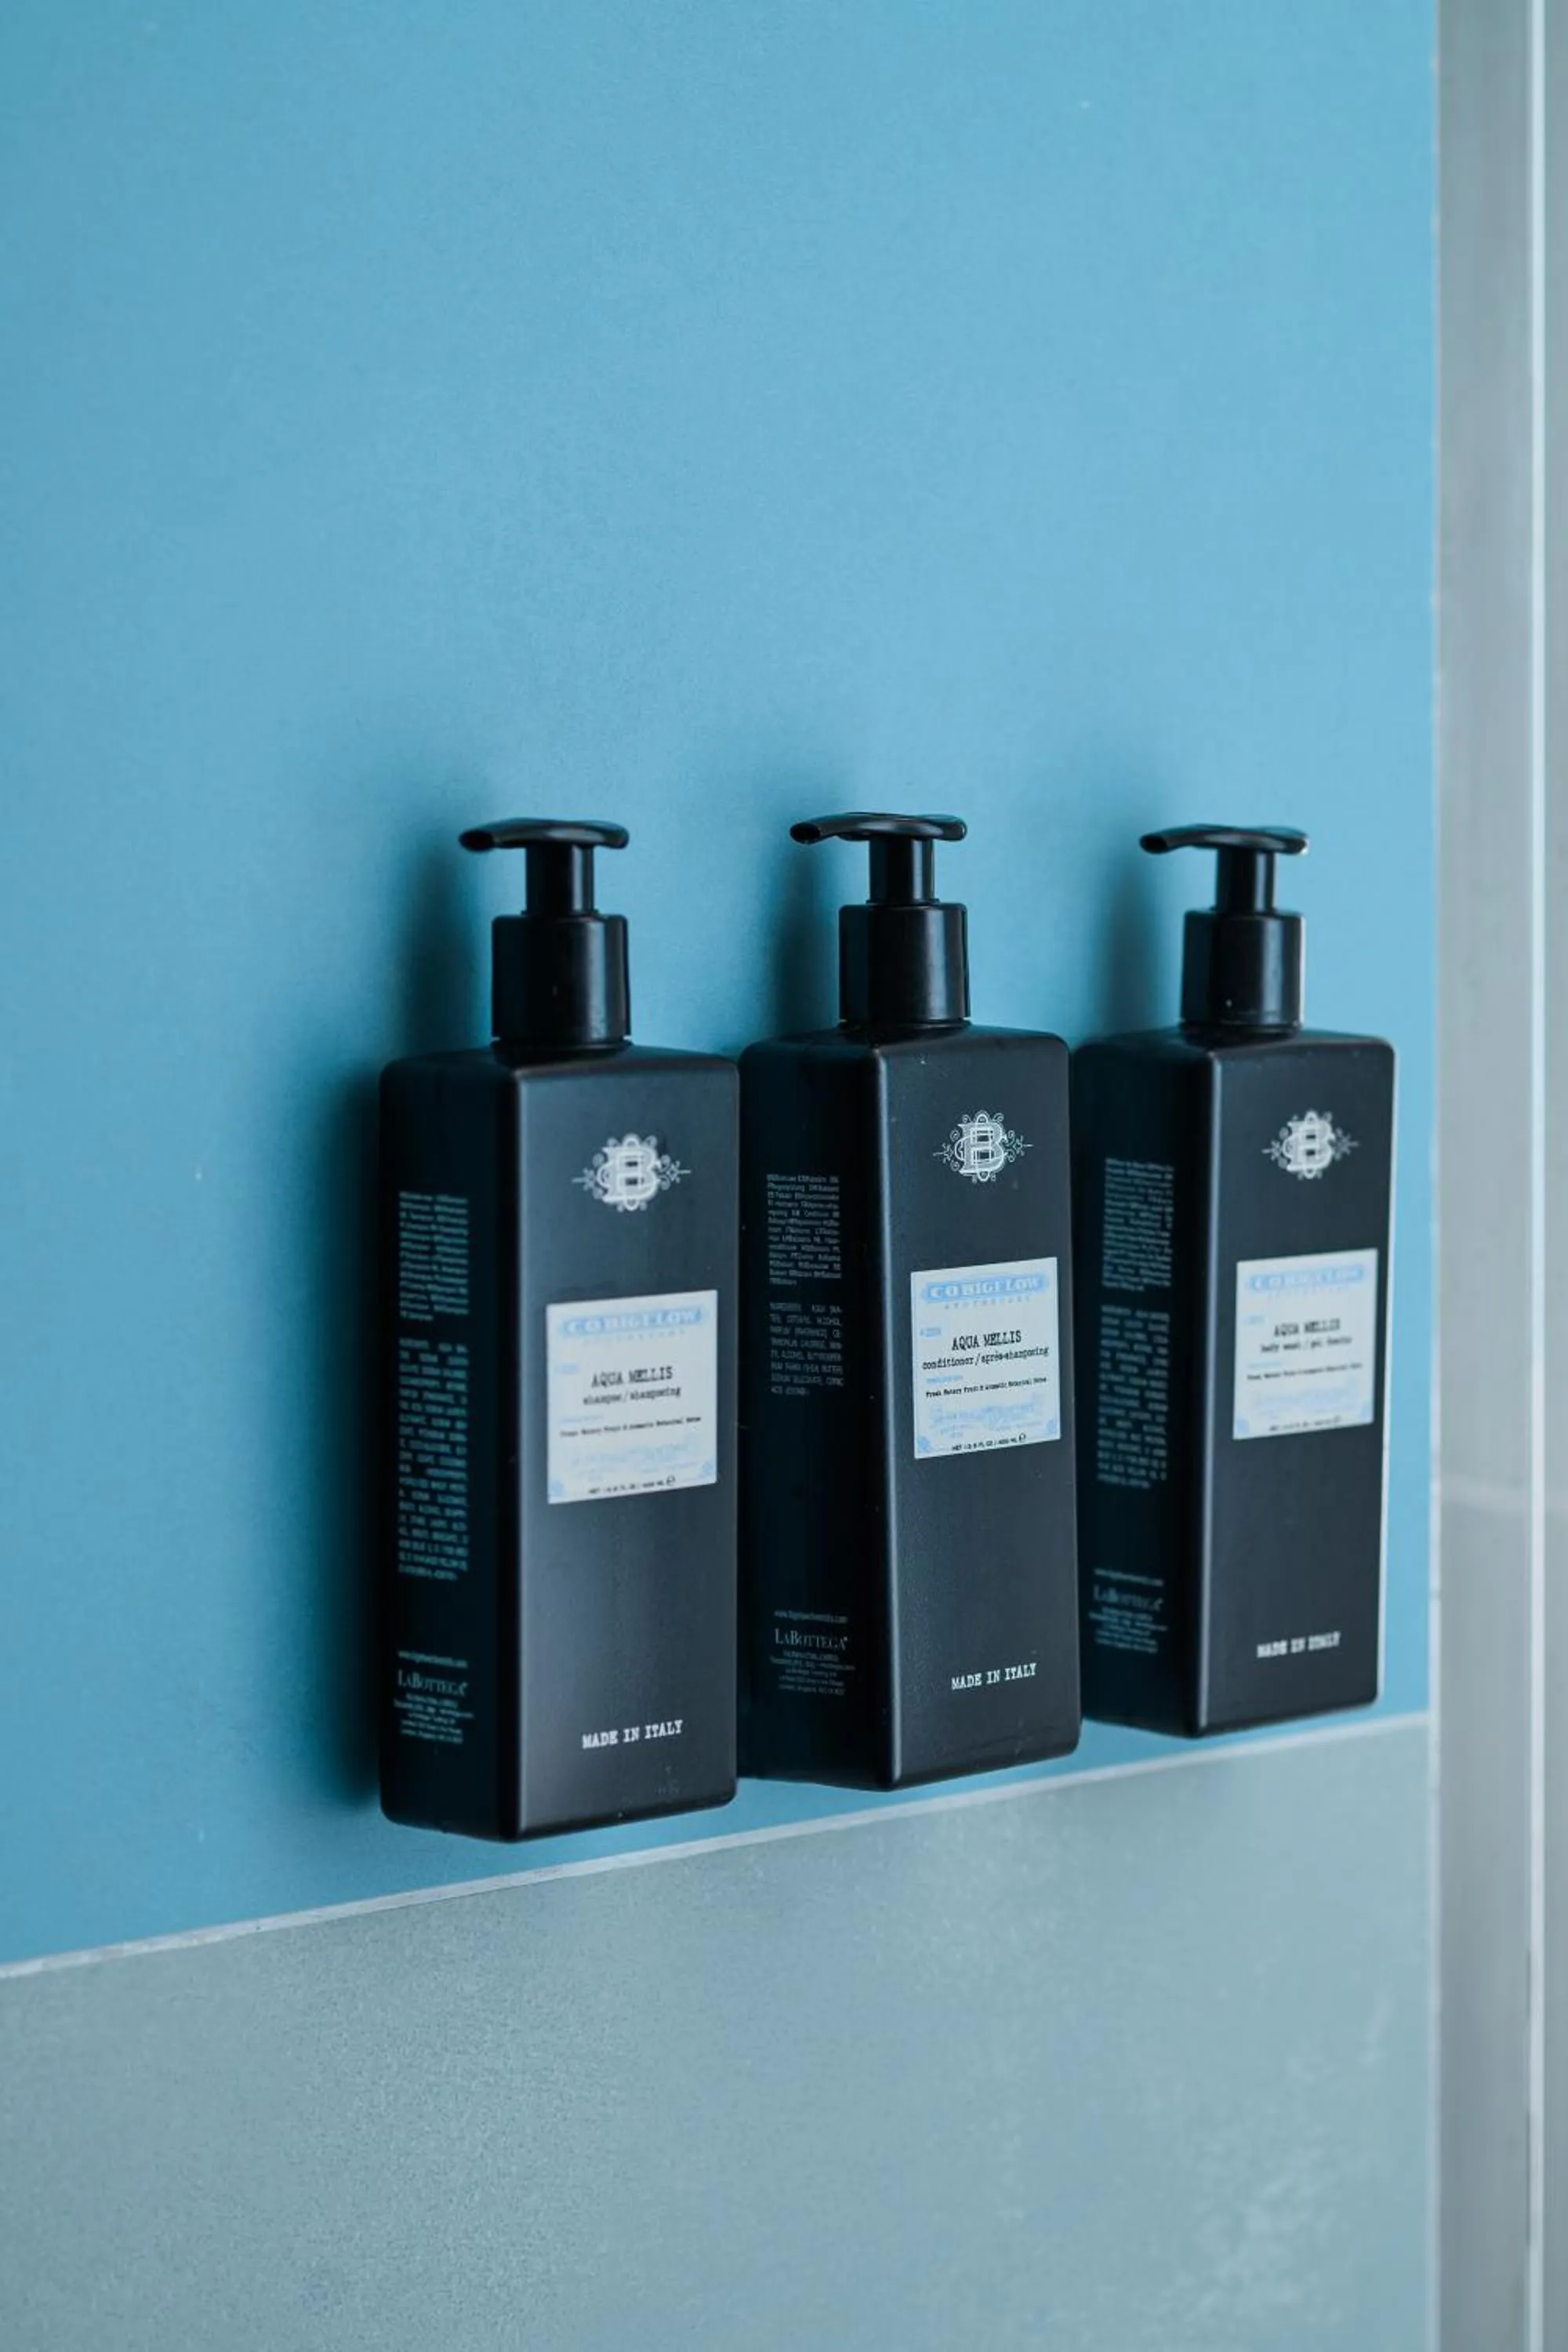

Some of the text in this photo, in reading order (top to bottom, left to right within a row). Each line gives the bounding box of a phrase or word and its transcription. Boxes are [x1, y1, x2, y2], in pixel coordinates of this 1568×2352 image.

[951, 1330, 1022, 1351] AQUA MELLIS
[591, 1366, 673, 1388] AQUA MELLIS
[951, 1662, 1037, 1690] MADE IN ITALY
[582, 1719, 684, 1749] MADE IN ITALY
